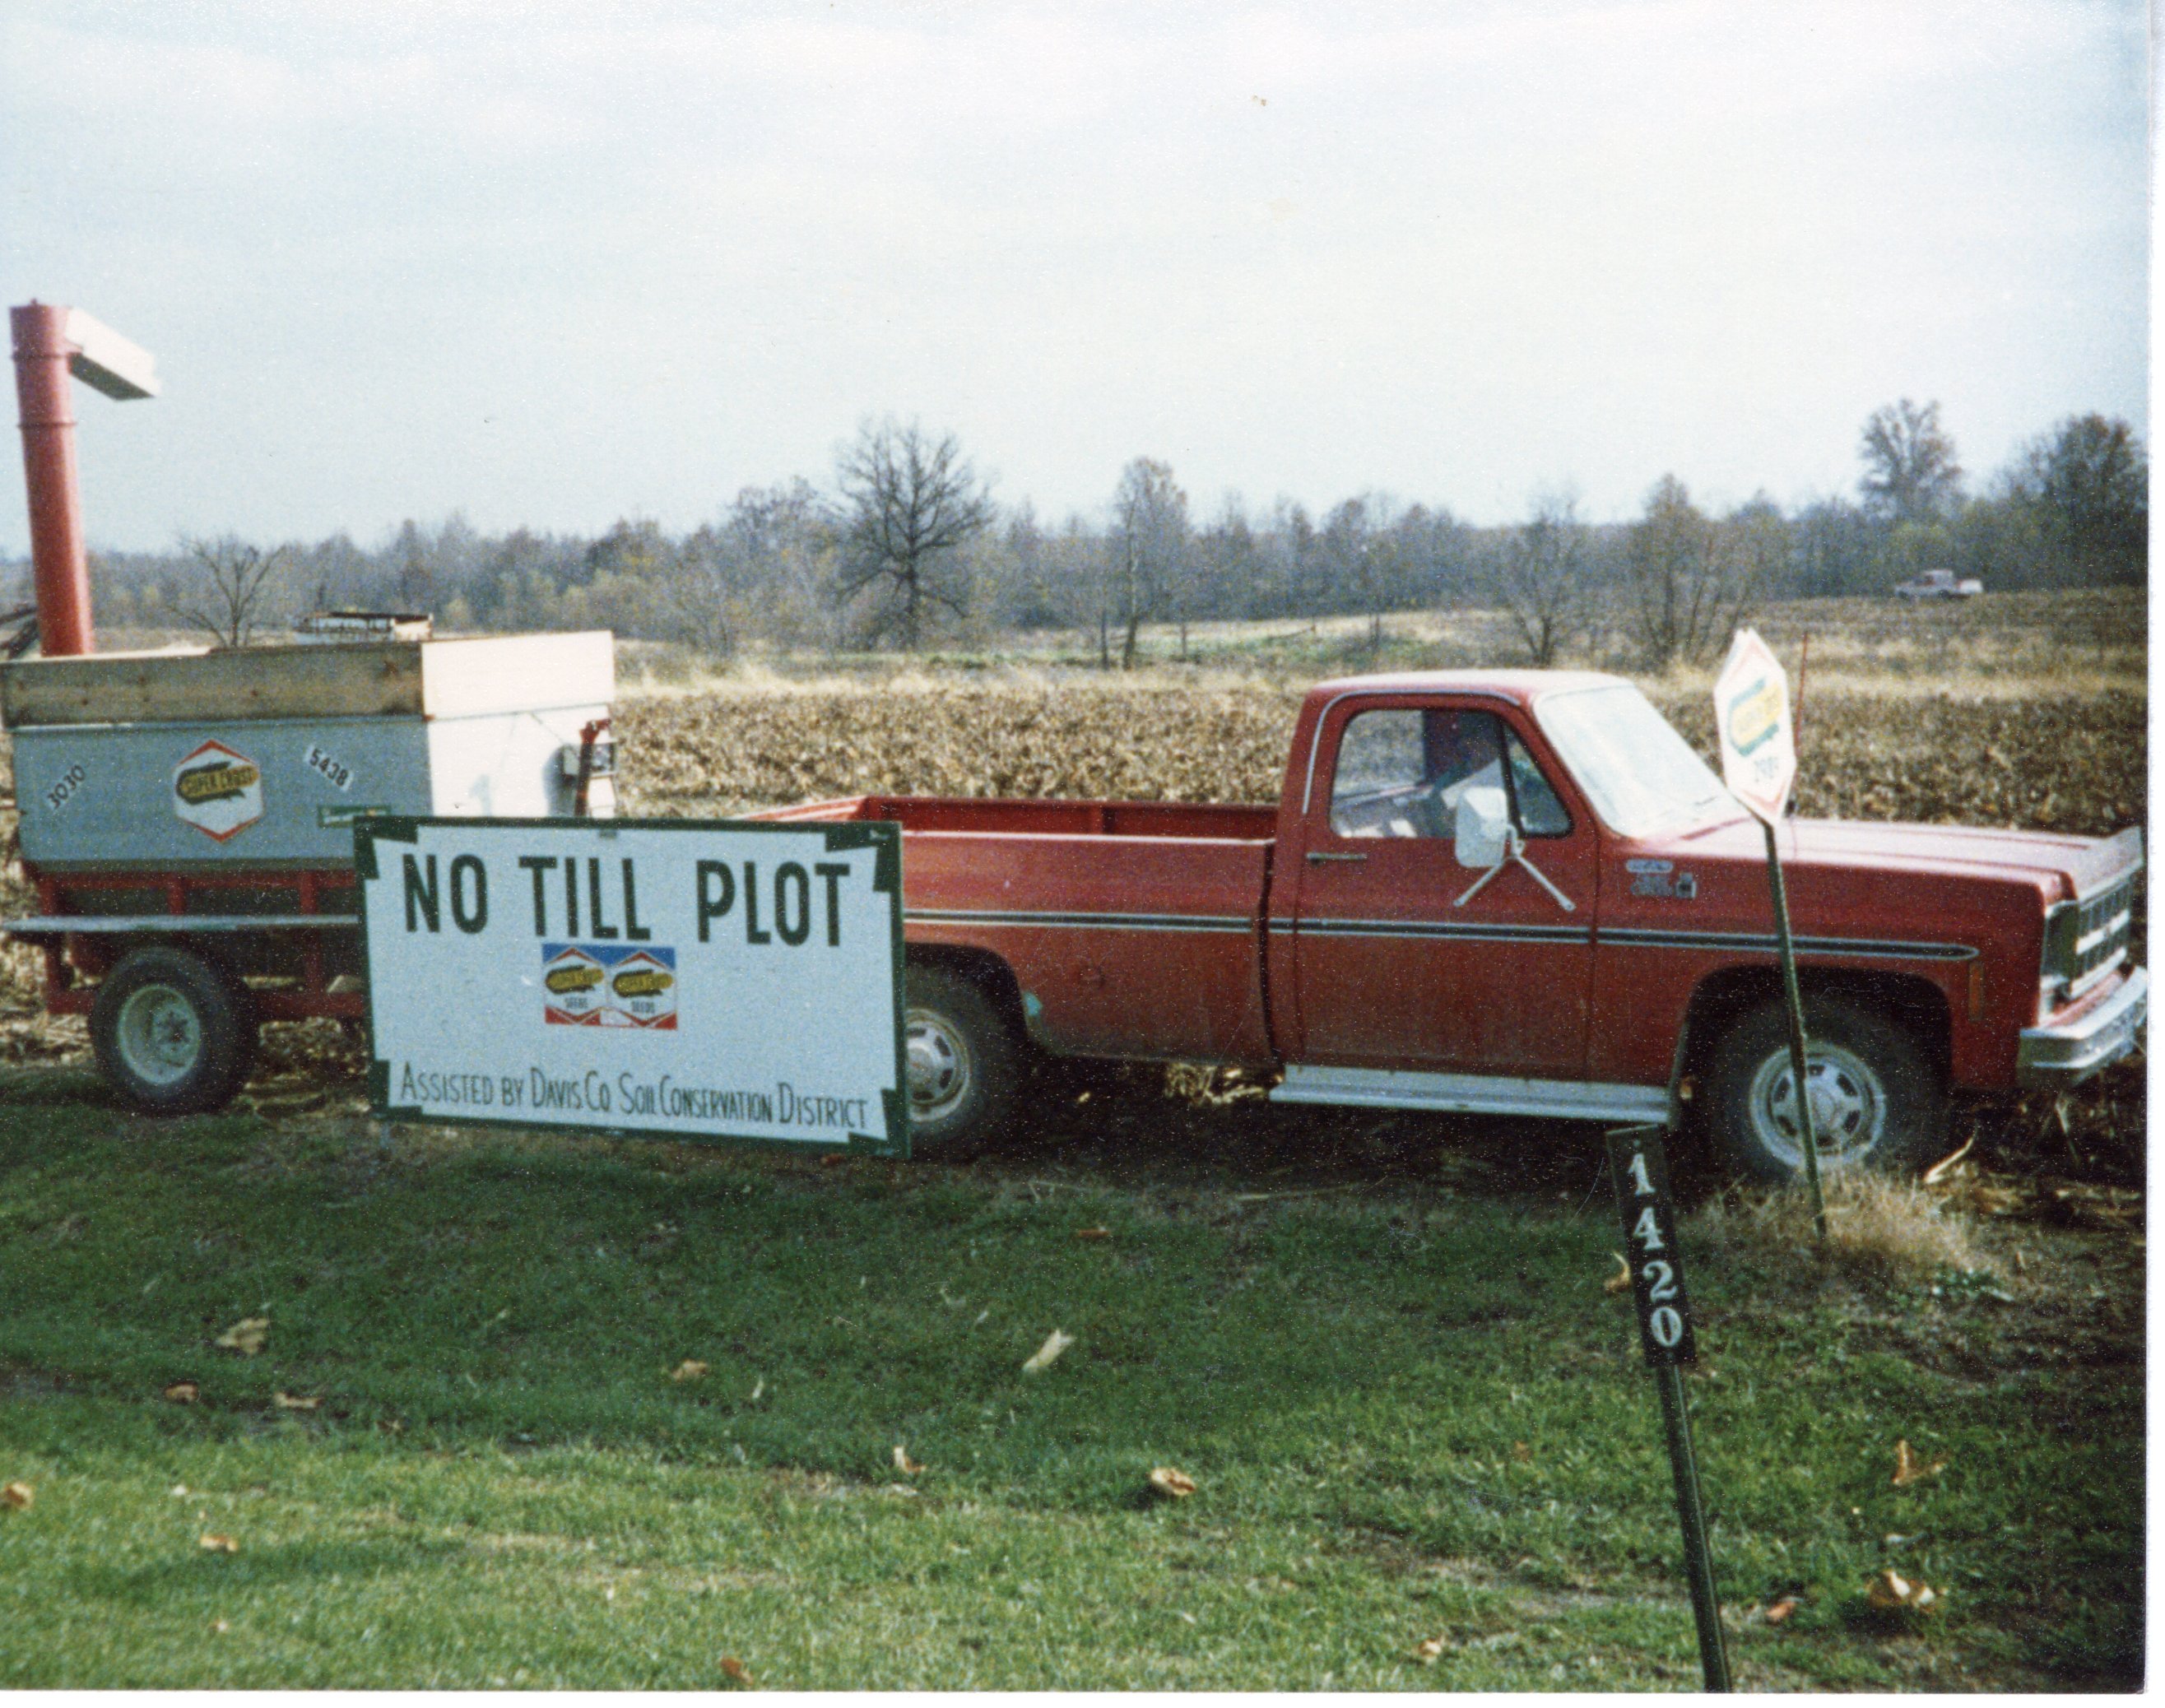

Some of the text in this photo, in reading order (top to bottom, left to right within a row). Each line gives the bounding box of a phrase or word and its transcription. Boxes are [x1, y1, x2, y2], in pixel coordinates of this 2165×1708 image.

[48, 764, 86, 808] 3030
[402, 854, 850, 946] NO TILL PLOT
[401, 1061, 494, 1105] ASSISTED
[501, 1077, 524, 1107] BY
[619, 1072, 656, 1115] SOIL
[659, 1074, 773, 1124] CONSERVATION
[778, 1081, 868, 1129] DISTRICT
[1627, 1153, 1683, 1348] 1420
